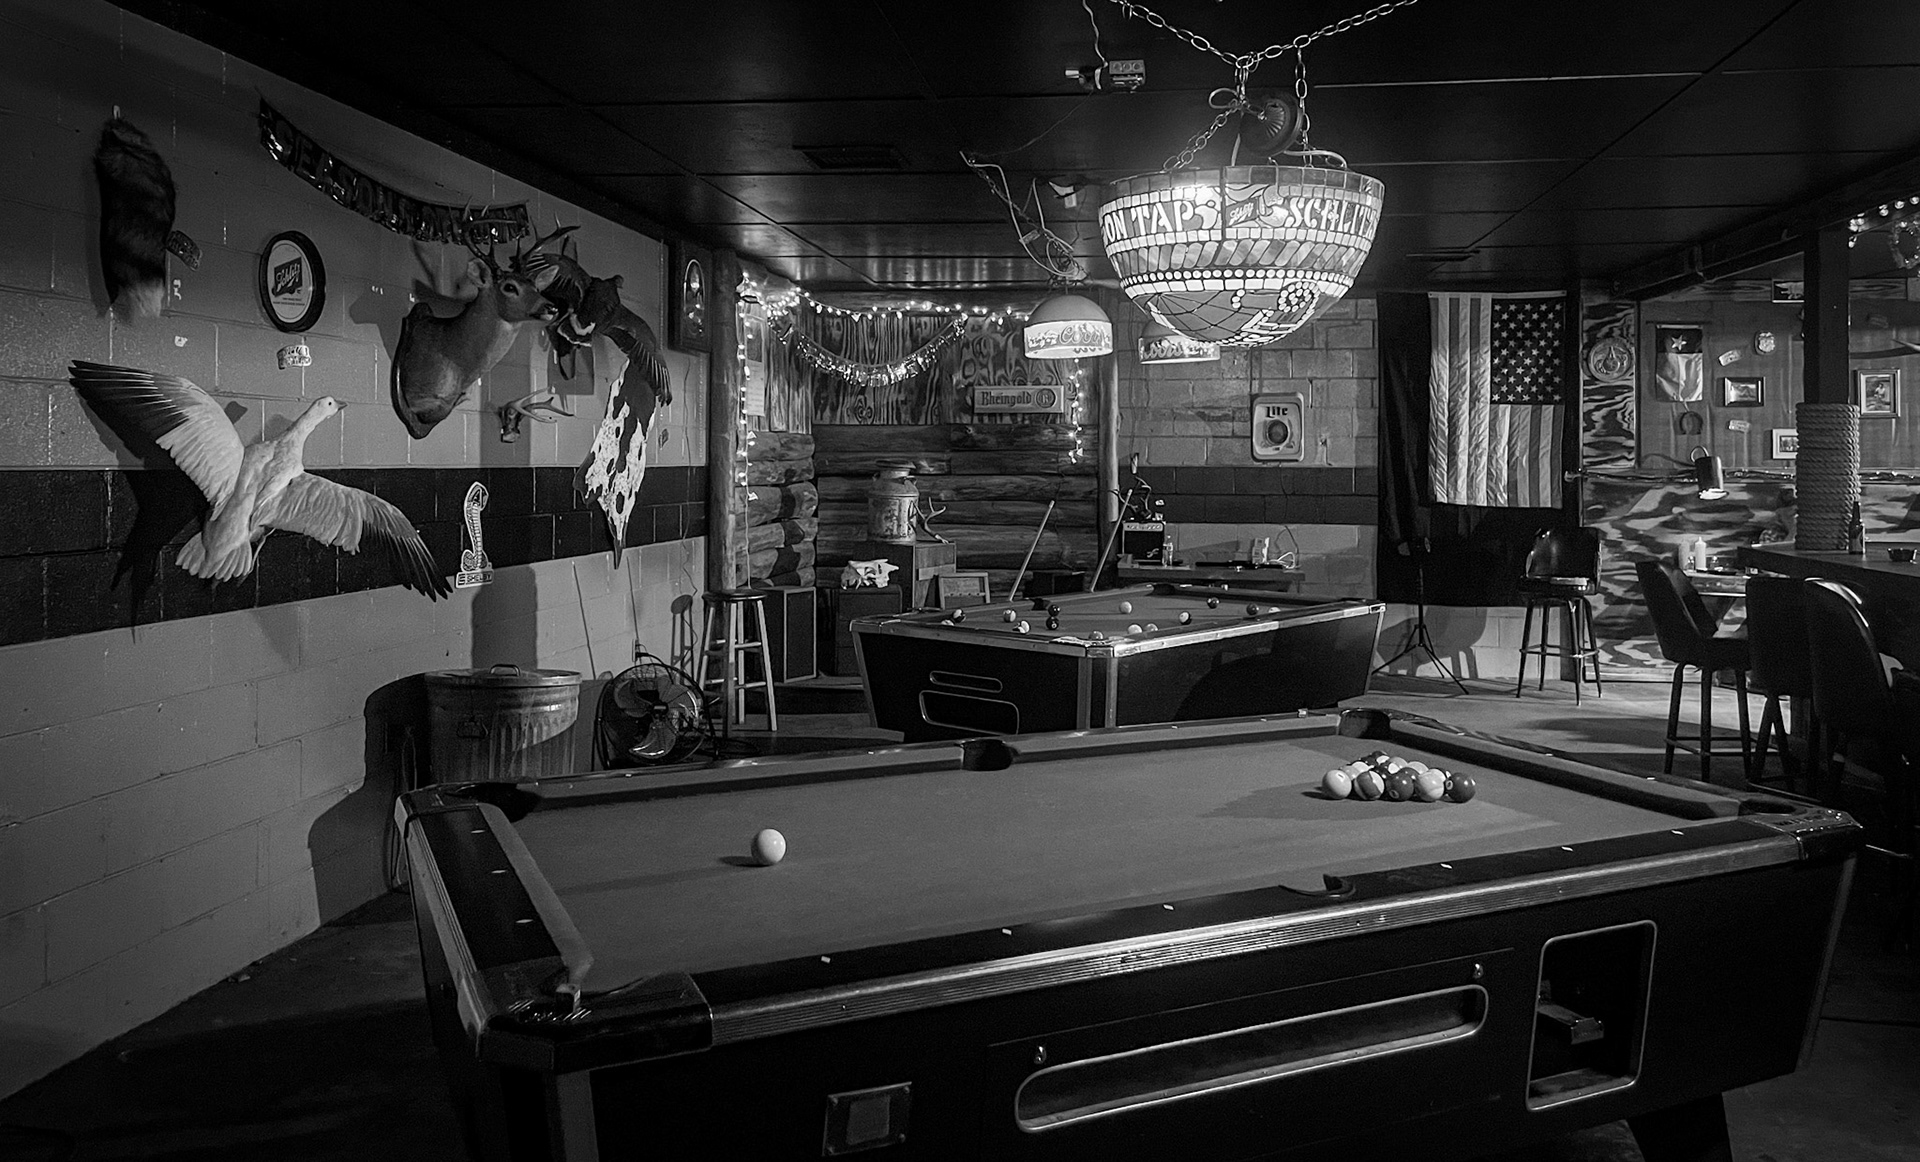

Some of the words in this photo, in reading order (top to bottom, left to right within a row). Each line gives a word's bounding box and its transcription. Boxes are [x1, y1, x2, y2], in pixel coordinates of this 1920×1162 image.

[1104, 209, 1128, 242] ON
[1130, 200, 1195, 235] TAP
[276, 263, 301, 292] Schlitz
[981, 391, 1032, 408] Rheingold
[1266, 406, 1288, 418] Lite
